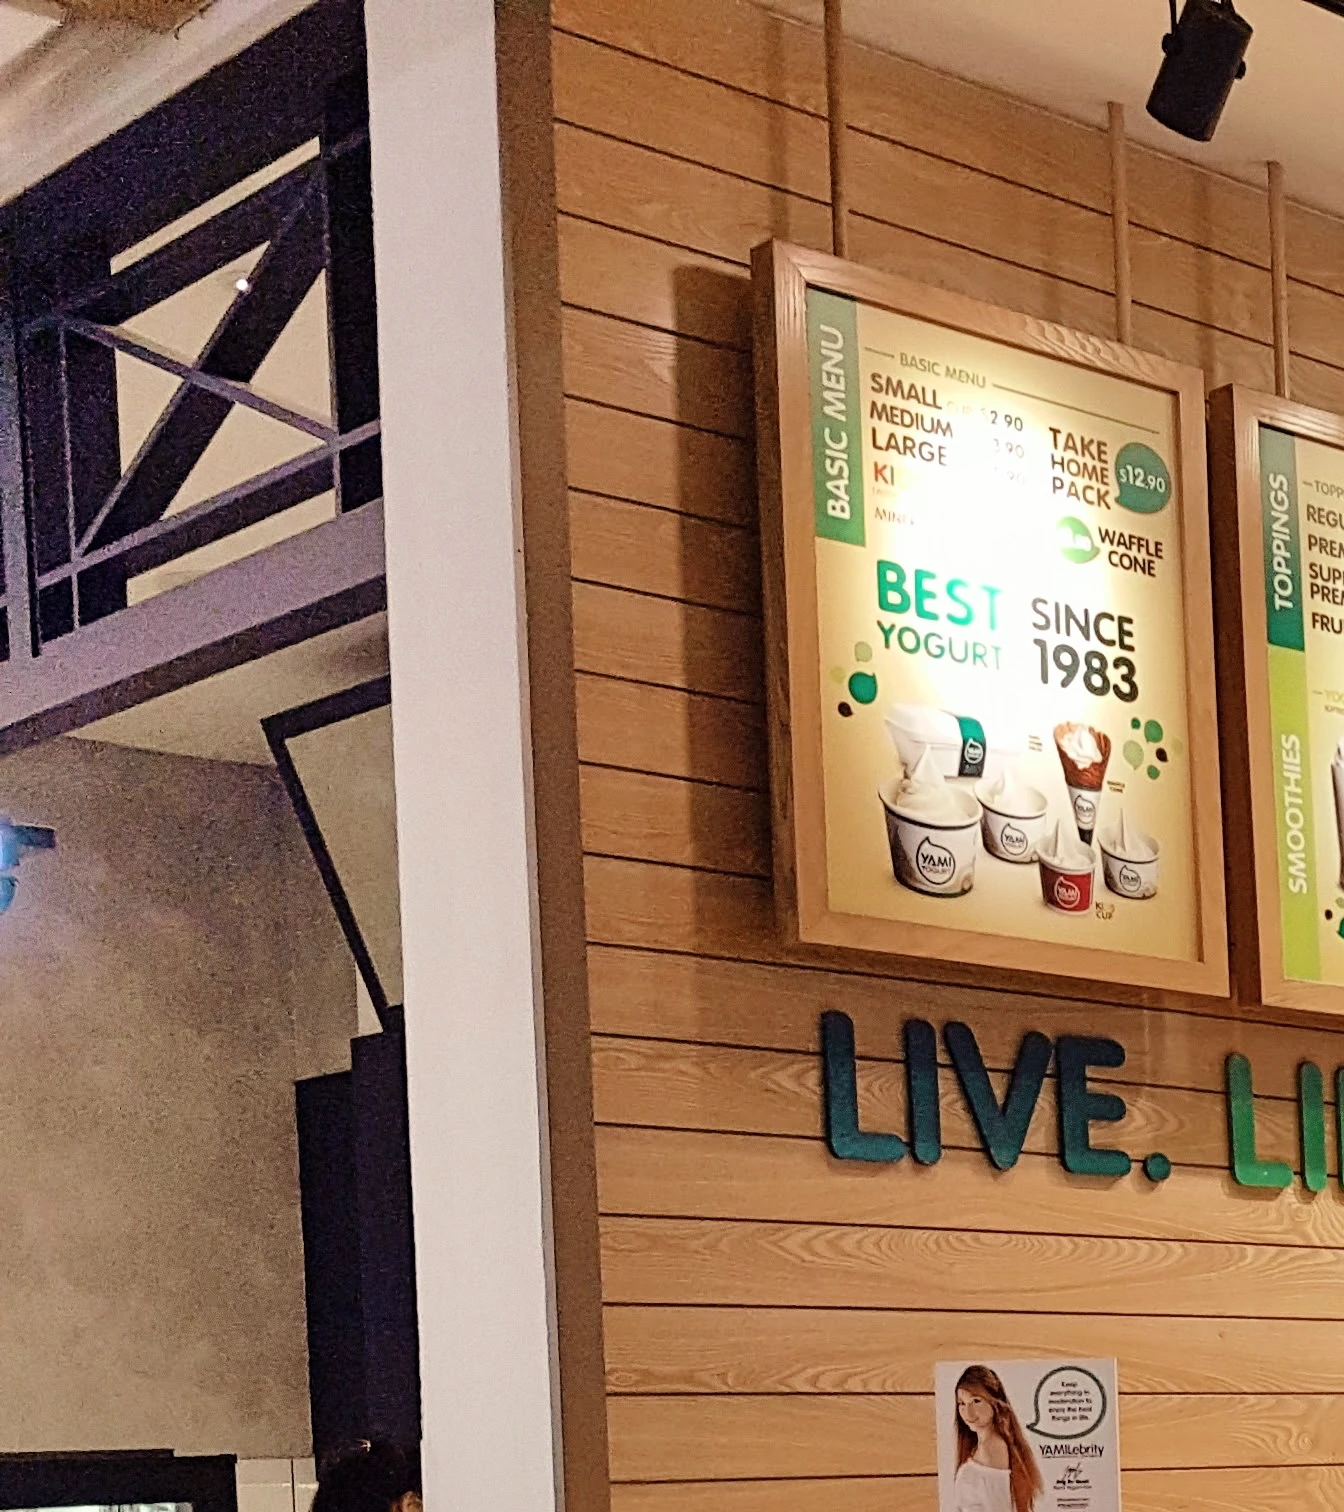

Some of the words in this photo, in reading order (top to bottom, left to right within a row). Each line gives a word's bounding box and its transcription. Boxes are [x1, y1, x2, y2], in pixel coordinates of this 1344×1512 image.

[819, 323, 847, 422] MENU
[899, 352, 941, 377] BASIC
[945, 364, 987, 389] MENU
[870, 372, 943, 410] SMALL
[869, 400, 953, 439] MEDIUM
[871, 426, 948, 467] LARGE
[1048, 426, 1109, 465] TAKE
[823, 427, 852, 521] BASIC
[1051, 453, 1110, 487] HOME
[1119, 464, 1166, 493] $12.90
[1052, 476, 1111, 511] PACK
[1098, 526, 1164, 560] WAFFLE
[1268, 472, 1294, 612] TOPPINGS
[1108, 550, 1157, 578] CONE
[877, 559, 1004, 633] BEST
[1031, 597, 1135, 653] SINCE
[876, 620, 1003, 672] YOGURT
[1033, 638, 1140, 704] 1983
[1281, 733, 1307, 896] SMOOTHIES
[921, 852, 952, 868] YAMI
[819, 1009, 1173, 1182] LIVE.
